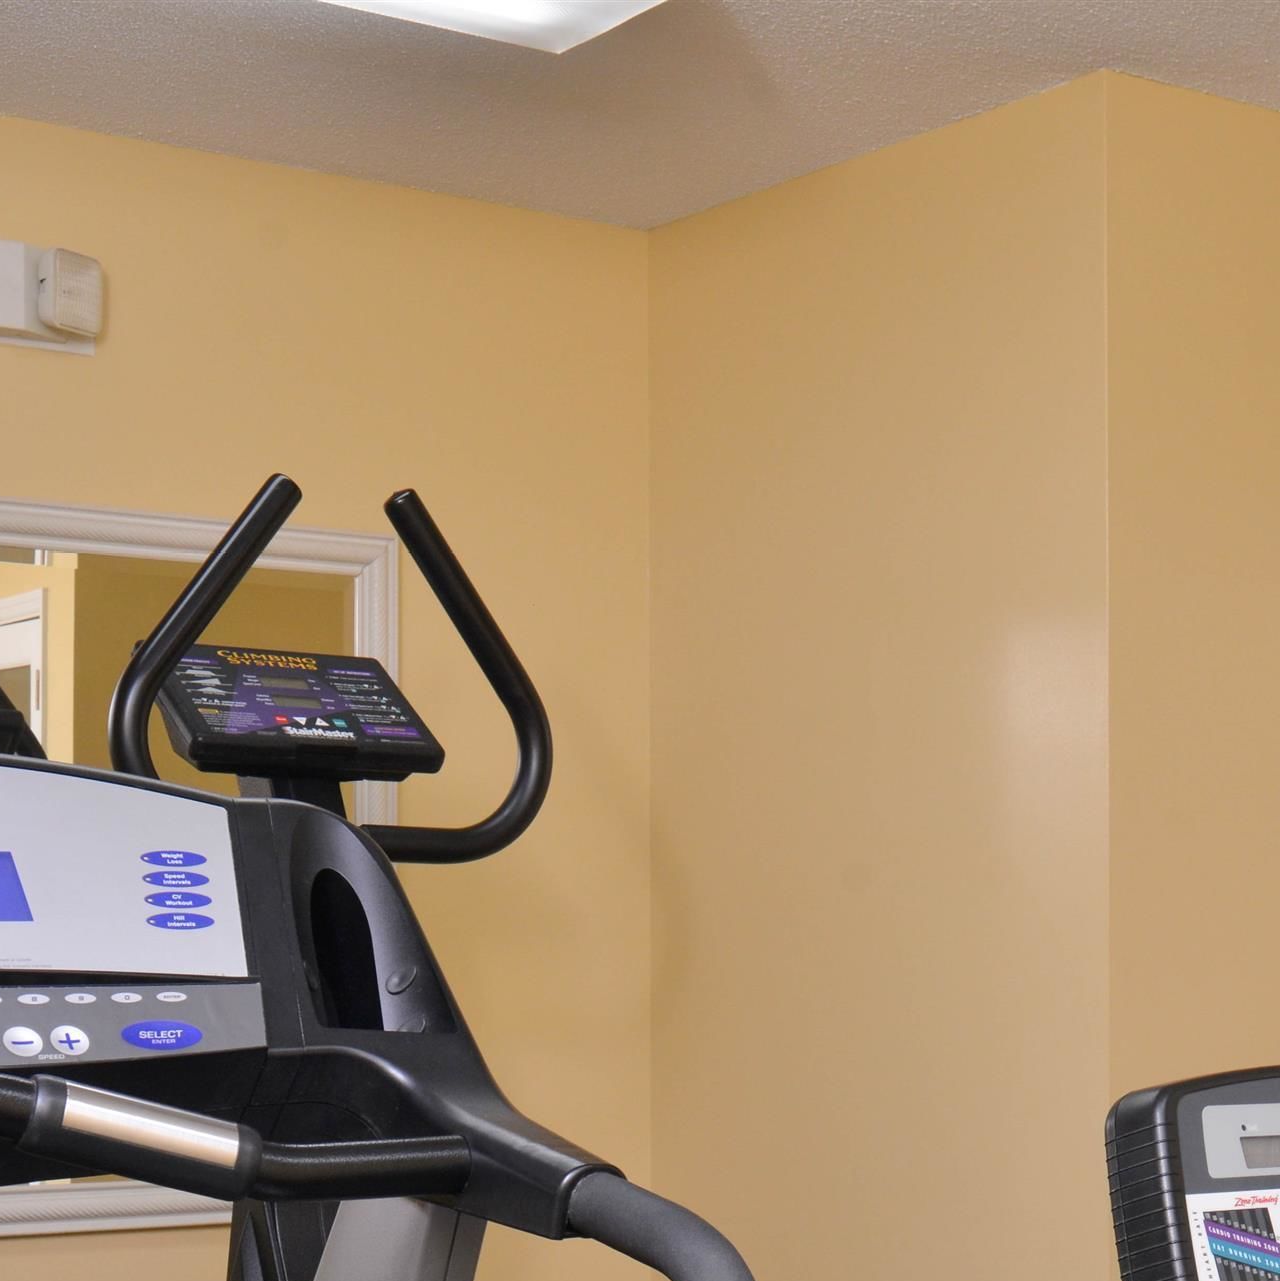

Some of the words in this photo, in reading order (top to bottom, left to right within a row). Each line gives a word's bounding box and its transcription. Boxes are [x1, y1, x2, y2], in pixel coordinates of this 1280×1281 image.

[216, 649, 317, 664] CLIMBING
[226, 656, 318, 671] SYSTEMS
[284, 726, 355, 738] StairMaster
[138, 1029, 183, 1039] SELECT
[1234, 1197, 1251, 1207] Zone
[1251, 1194, 1280, 1205] Training
[1208, 1226, 1231, 1239] CARDIO
[1233, 1233, 1262, 1248] TRAINING
[1264, 1243, 1280, 1254] ZONE
[1212, 1243, 1225, 1252] FAT
[1229, 1248, 1262, 1263] BURNING
